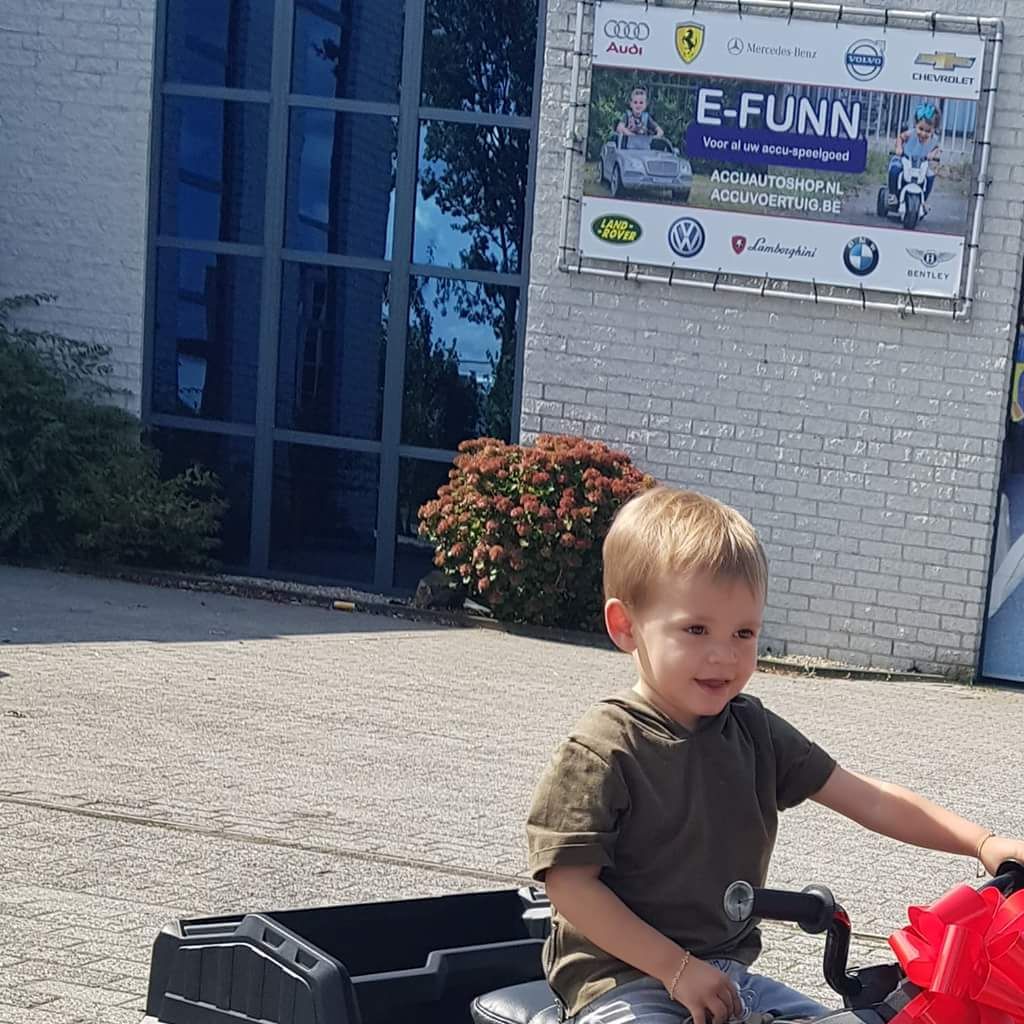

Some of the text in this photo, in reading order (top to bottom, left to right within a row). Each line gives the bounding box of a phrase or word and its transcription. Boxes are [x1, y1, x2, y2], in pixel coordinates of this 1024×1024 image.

[606, 42, 643, 56] Audi
[849, 56, 882, 66] VOLVO
[912, 72, 975, 86] CHEVROLET
[696, 88, 861, 139] E-FUNN
[702, 136, 850, 163] Voor al uw accu-speelgoed
[710, 169, 844, 195] ACCUAUTOSHOP.NL
[710, 188, 841, 214] ACCUVOERTUIG.BE
[600, 218, 629, 230] LAND
[602, 228, 638, 241] ROVER
[747, 237, 818, 259] Lamborghini
[907, 269, 950, 280] BENTLEY
